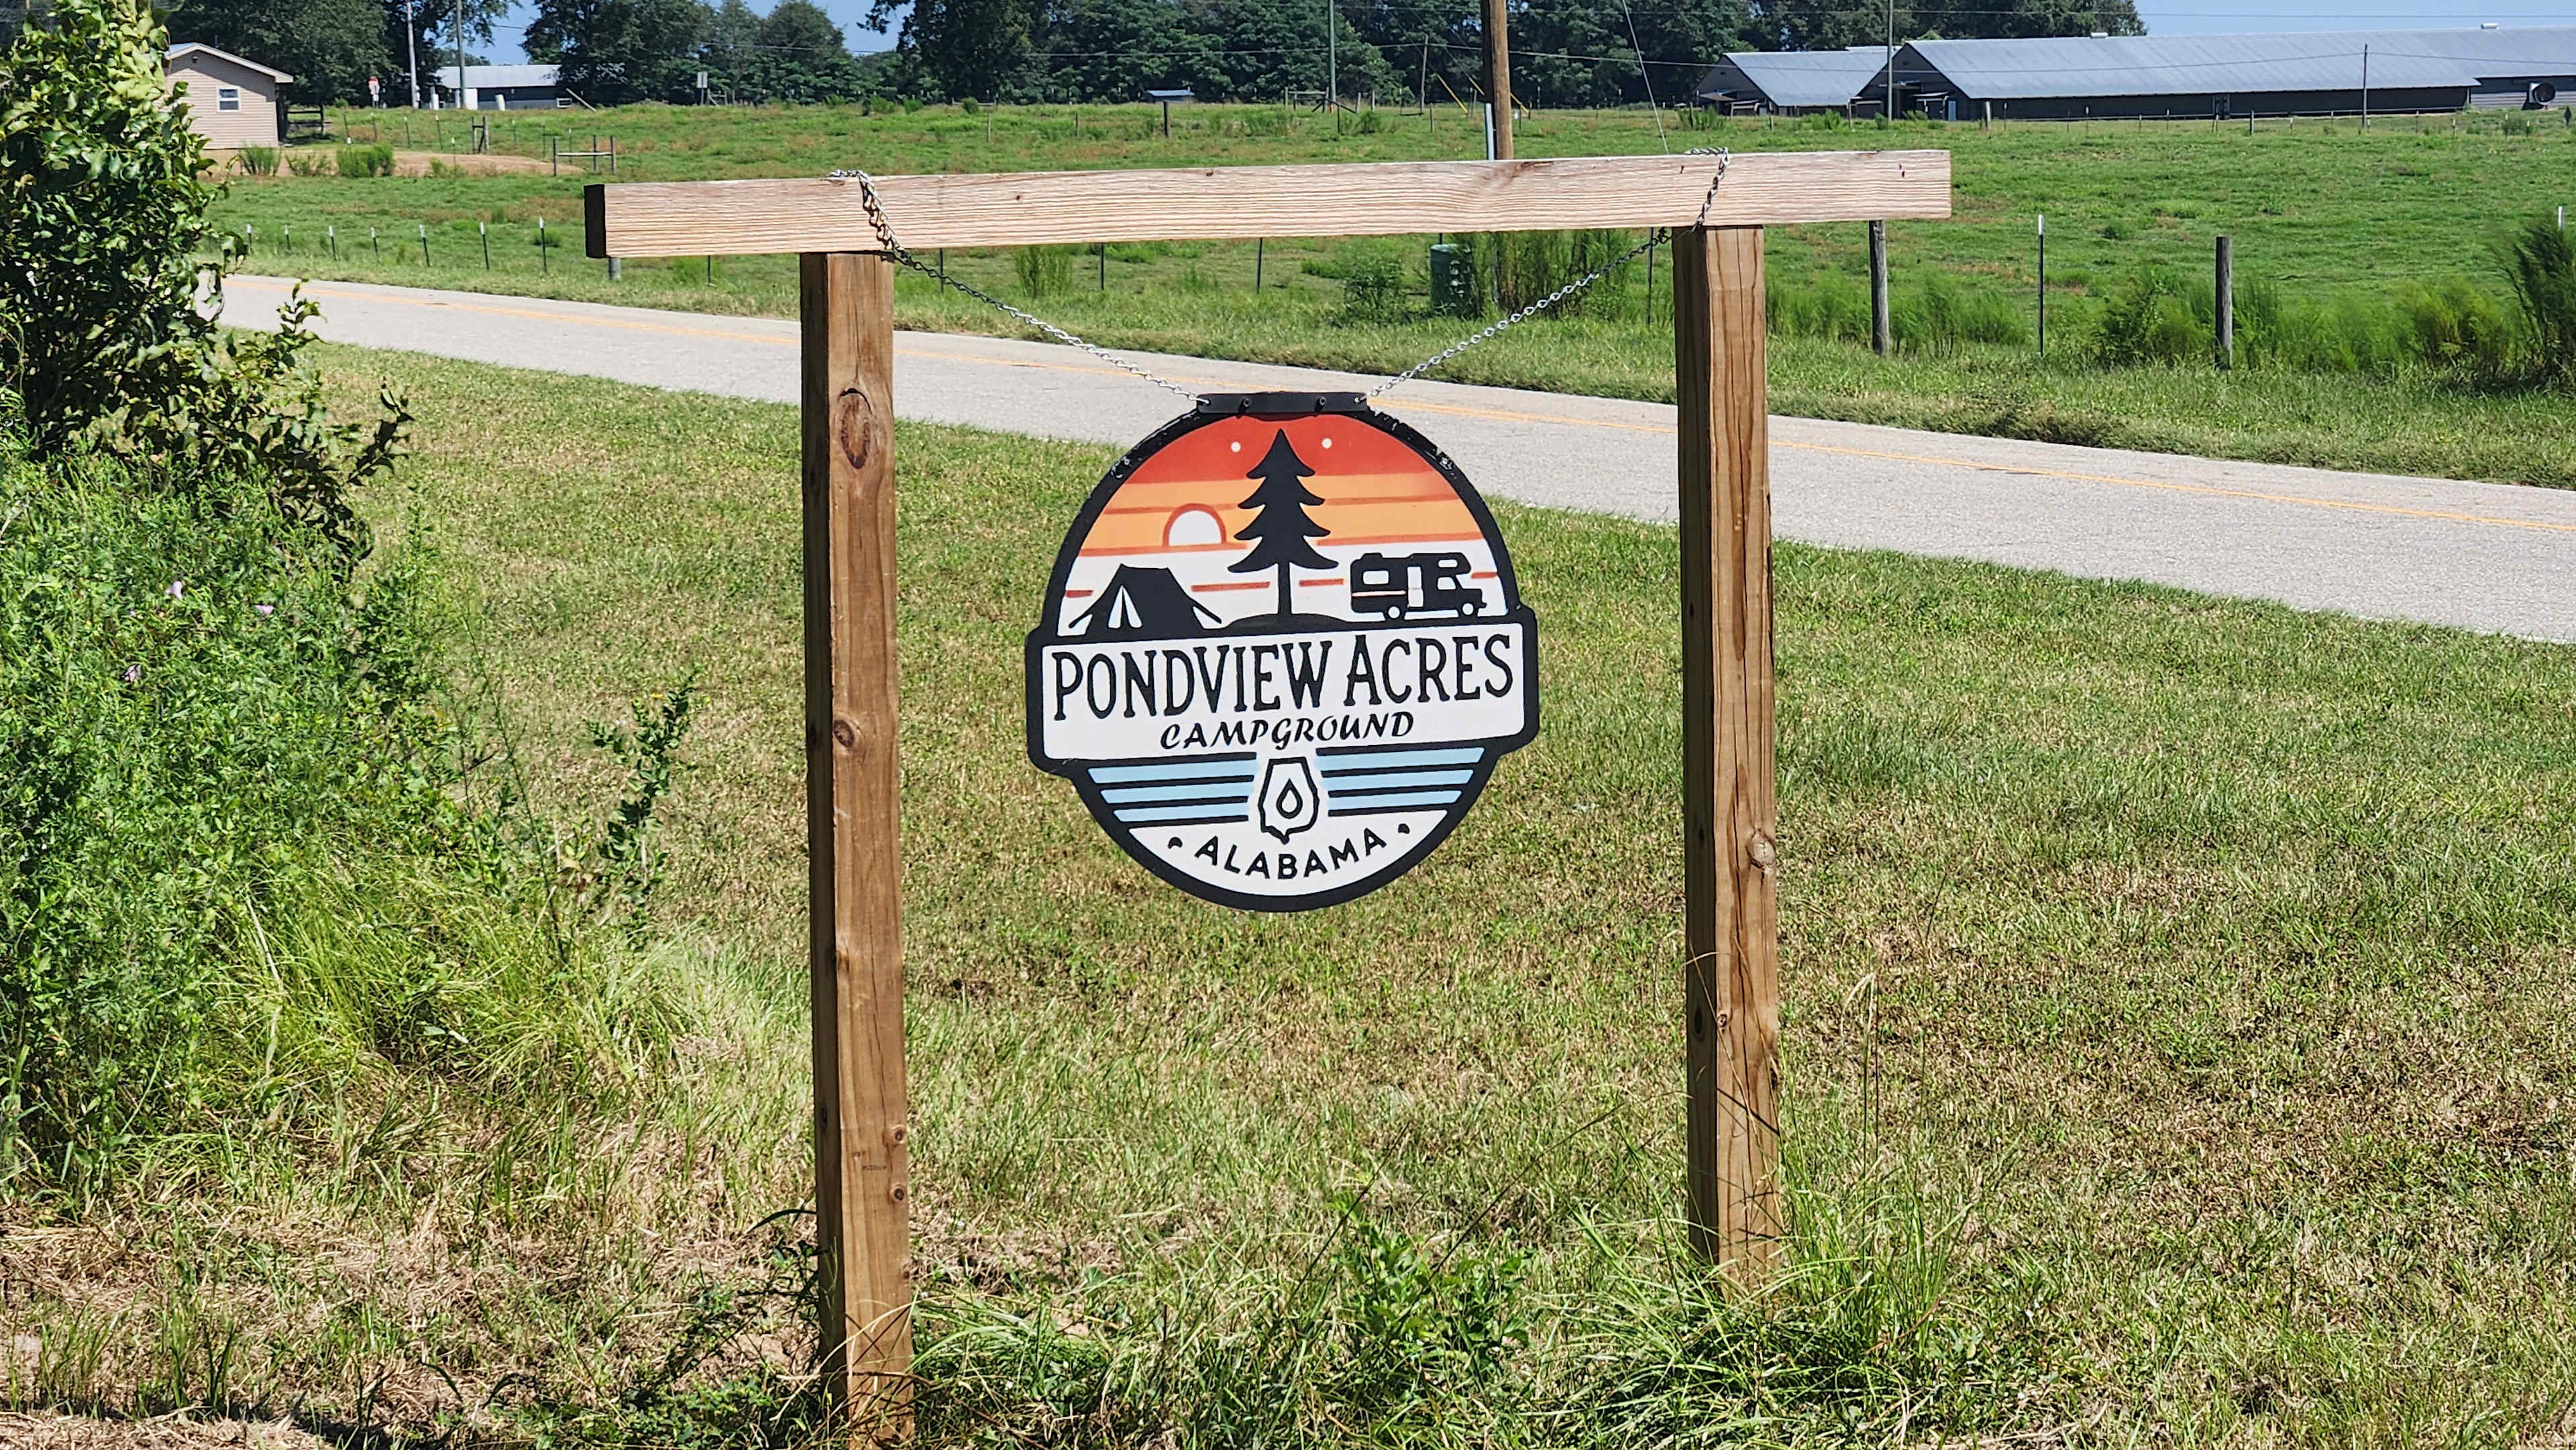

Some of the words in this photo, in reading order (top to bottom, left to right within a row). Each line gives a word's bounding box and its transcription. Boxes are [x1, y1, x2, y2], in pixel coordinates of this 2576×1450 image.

[1051, 640, 1334, 721] PONDVIEW
[1343, 633, 1514, 708] ACRES
[1159, 711, 1415, 750] CAMPGROUND
[1194, 828, 1387, 880] ALABAMA
